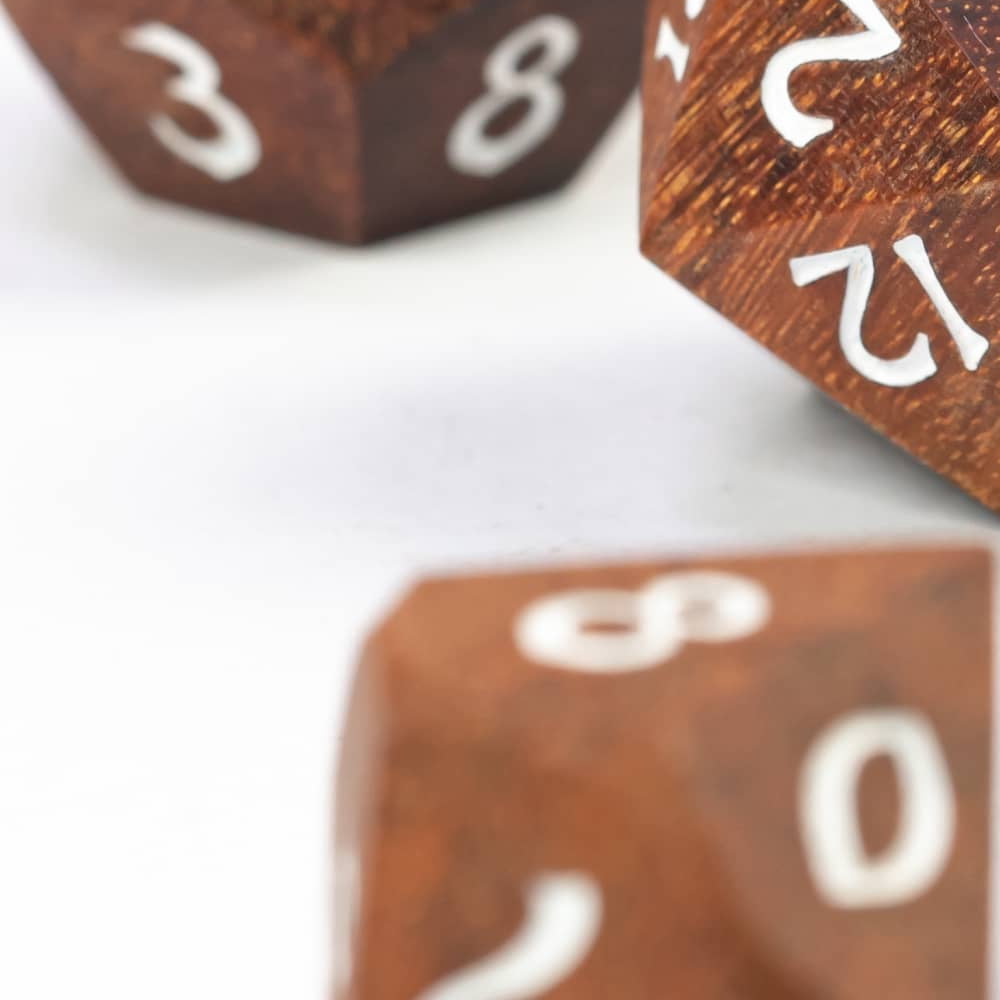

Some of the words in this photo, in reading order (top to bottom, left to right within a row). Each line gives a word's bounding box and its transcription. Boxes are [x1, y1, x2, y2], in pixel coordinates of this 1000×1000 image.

[126, 21, 261, 181] 3
[447, 15, 580, 177] 8
[788, 233, 990, 388] 12
[515, 571, 770, 673] 8
